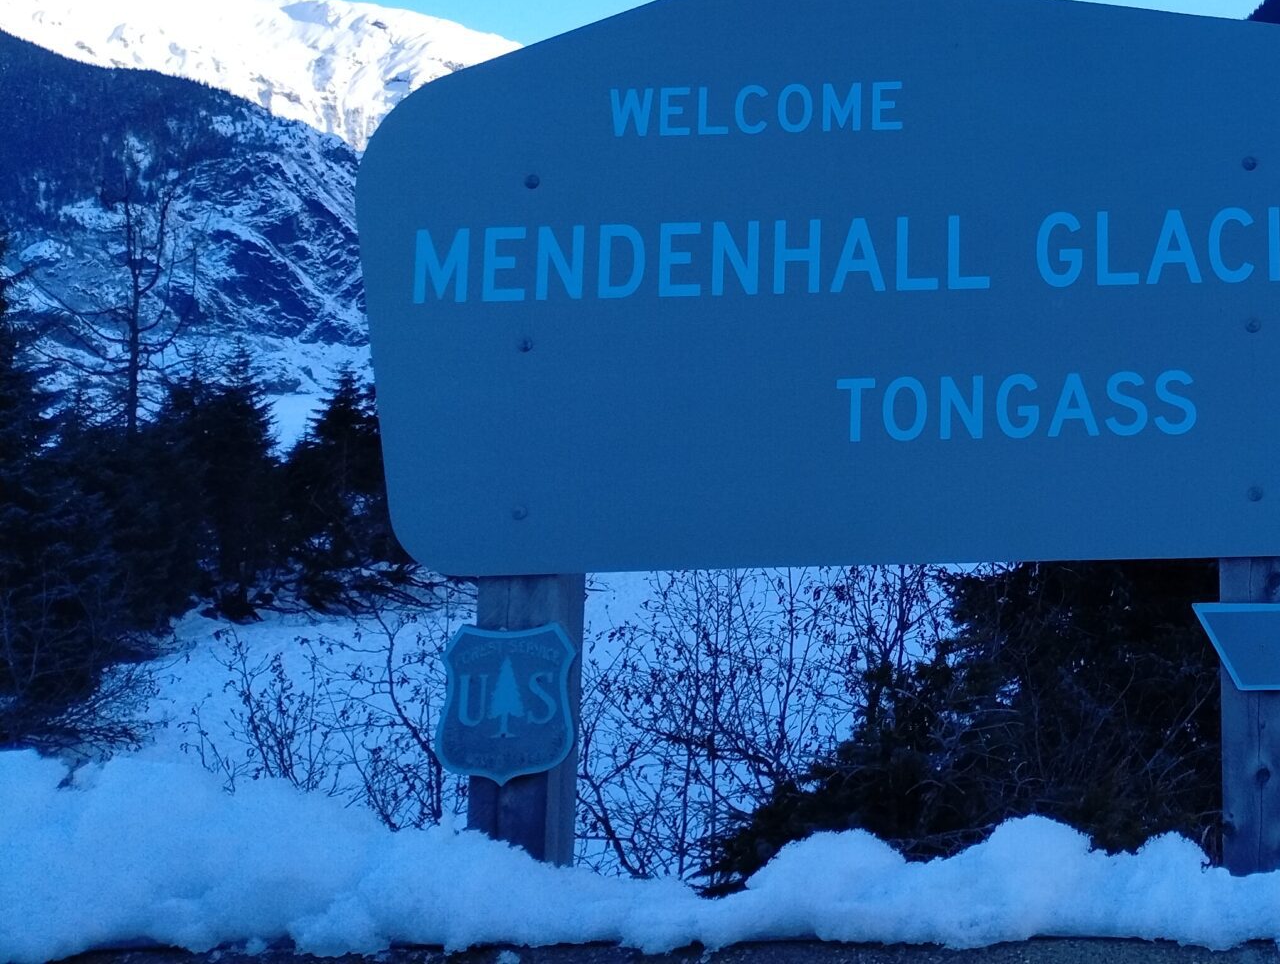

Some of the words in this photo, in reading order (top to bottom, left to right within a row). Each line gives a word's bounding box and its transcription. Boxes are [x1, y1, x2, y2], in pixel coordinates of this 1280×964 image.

[610, 81, 903, 137] WELCOME
[412, 214, 991, 305] MENDENHALL
[836, 369, 1197, 443] TONGASS
